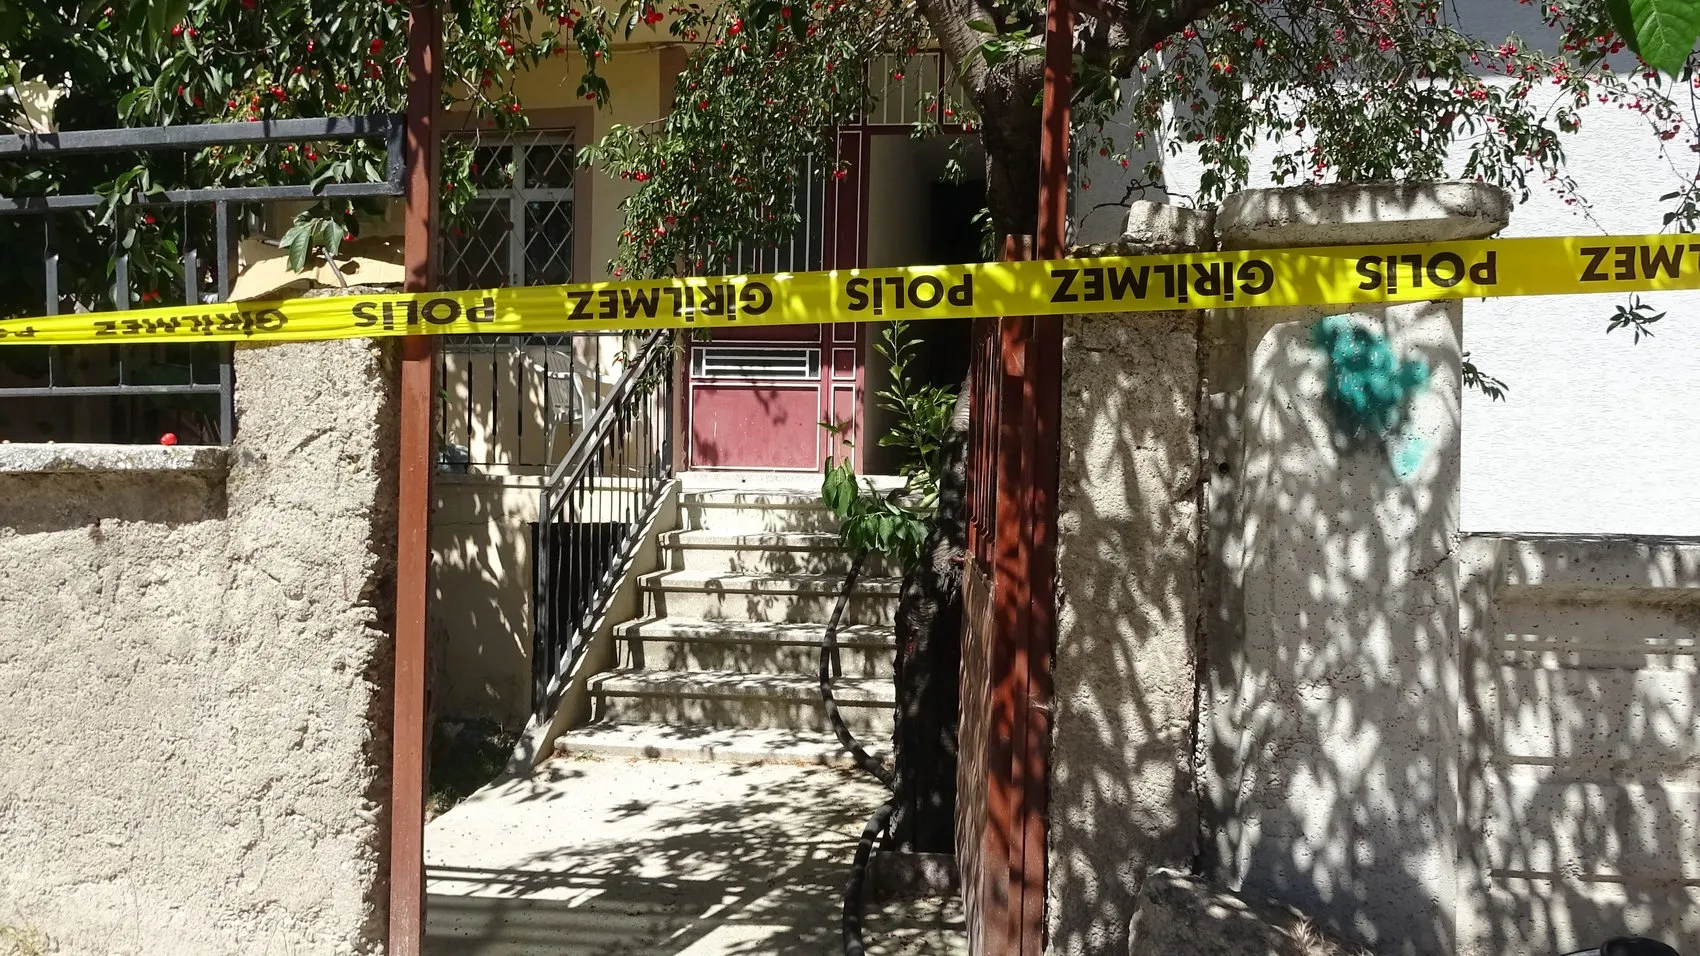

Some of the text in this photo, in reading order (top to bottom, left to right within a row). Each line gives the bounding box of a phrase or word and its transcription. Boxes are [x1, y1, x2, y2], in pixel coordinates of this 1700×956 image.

[1050, 259, 1274, 303] GİRİLMEZ
[1355, 251, 1497, 295] POLİS
[352, 297, 495, 330] POLİS
[567, 282, 773, 322] GİRİLMEZ
[845, 274, 973, 315] POLİS
